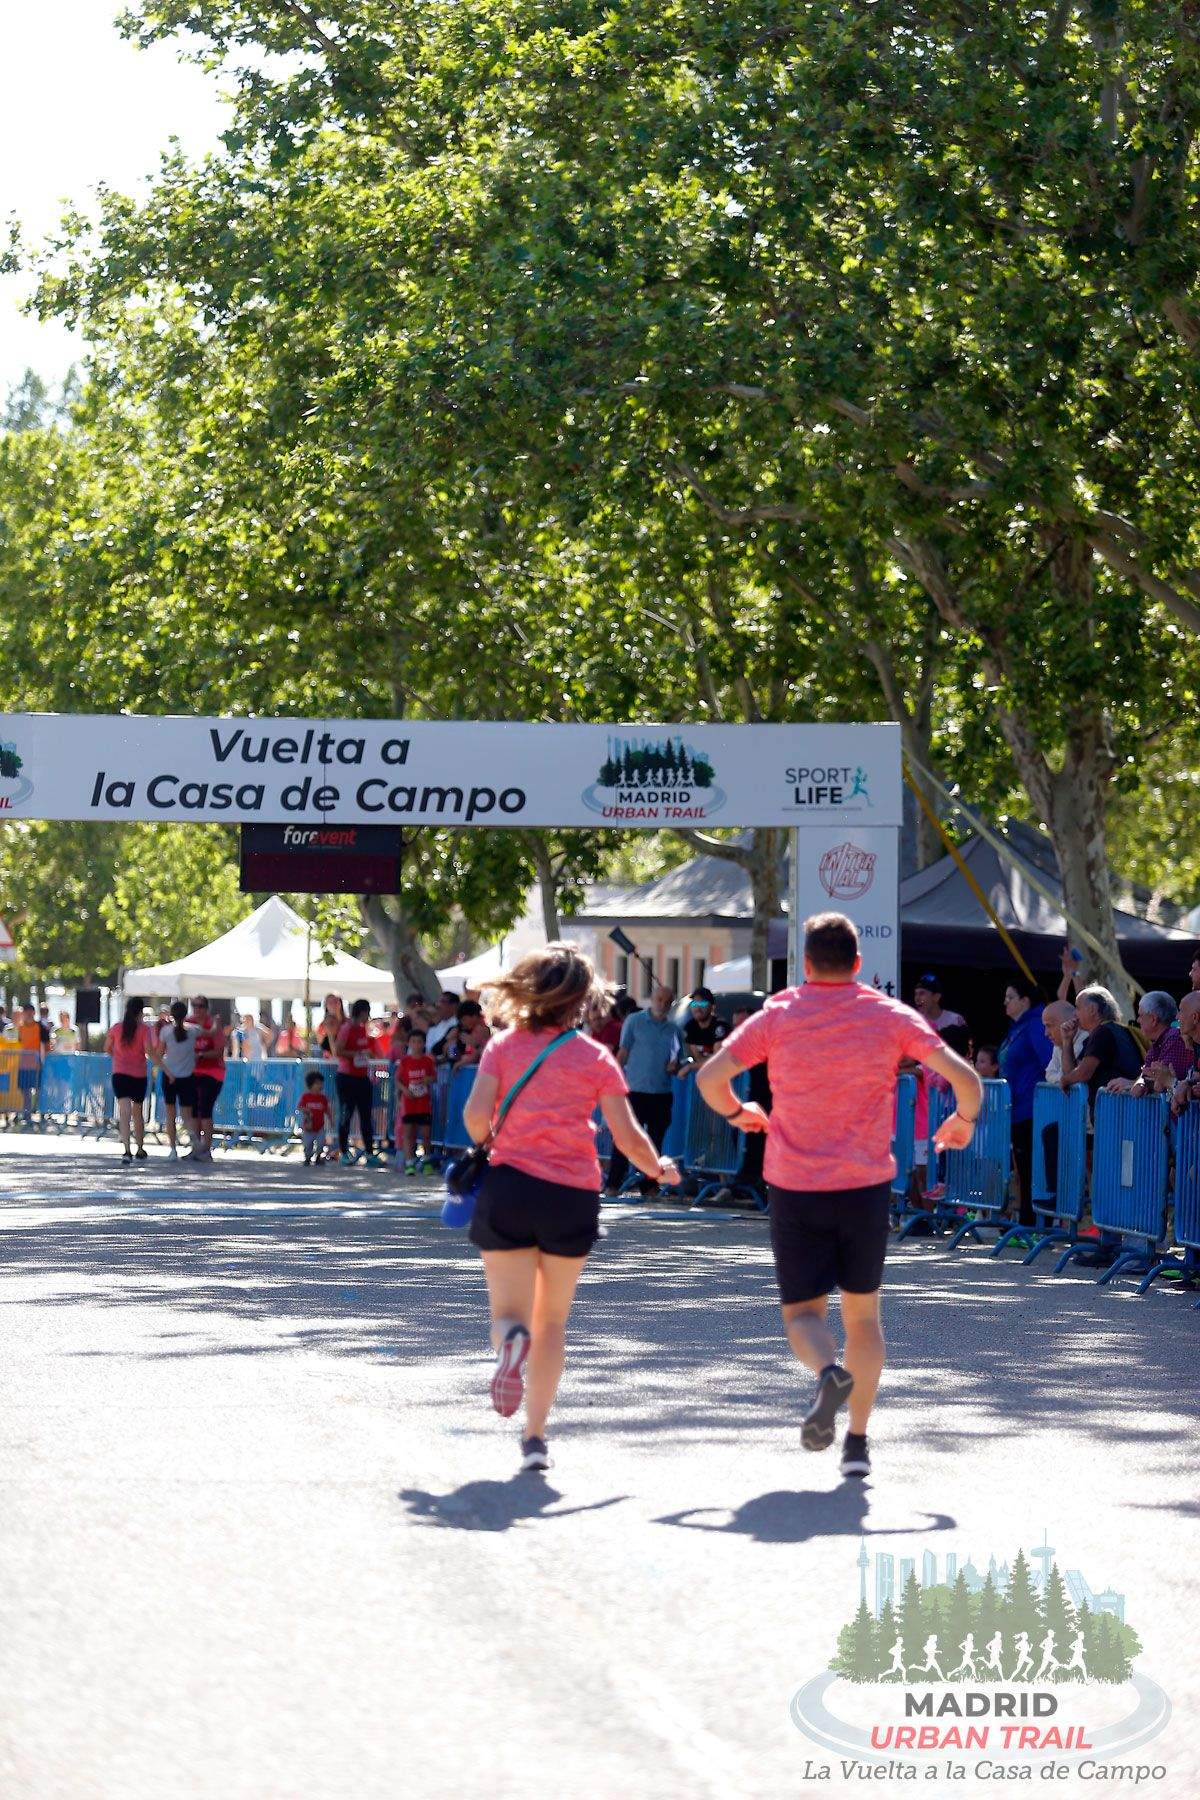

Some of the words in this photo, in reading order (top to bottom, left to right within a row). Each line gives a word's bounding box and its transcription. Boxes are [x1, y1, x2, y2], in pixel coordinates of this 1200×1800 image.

[210, 729, 365, 764] Vuelta
[380, 738, 410, 765] a
[785, 767, 851, 784] SPORT
[91, 772, 135, 807] la
[146, 775, 264, 810] Casa
[280, 777, 340, 811] de
[356, 779, 526, 821] Campo
[619, 791, 691, 804] MADRID
[794, 787, 842, 804] LIFE
[602, 806, 659, 818] URBAN
[664, 807, 707, 818] TRAIL
[283, 825, 357, 845] forevent
